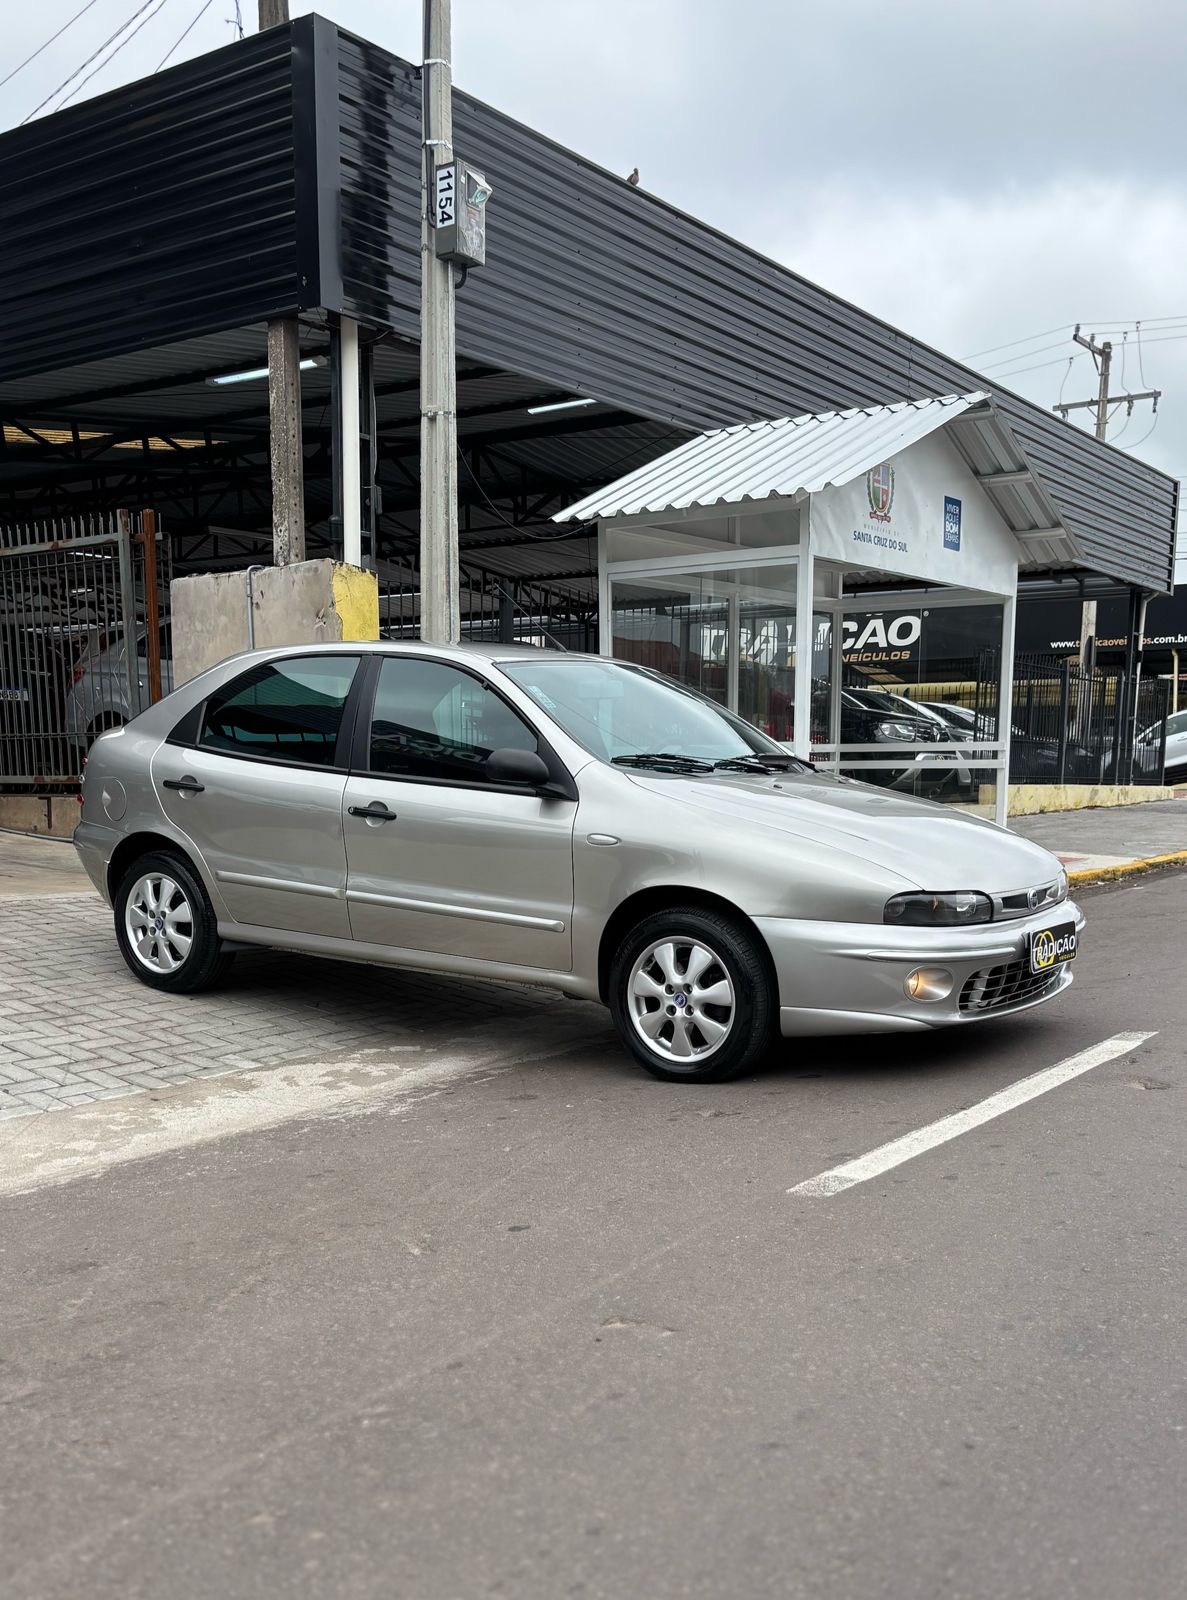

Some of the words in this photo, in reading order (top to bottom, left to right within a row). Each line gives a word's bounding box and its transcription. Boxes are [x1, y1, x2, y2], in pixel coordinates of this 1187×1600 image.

[438, 170, 453, 225] 1154
[945, 521, 959, 534] BOM
[853, 530, 872, 544] SANTA
[873, 535, 888, 548] CRUZ
[888, 539, 898, 550] DO
[898, 541, 908, 553] SUL
[1032, 934, 1076, 963] TRADIÇÃO
